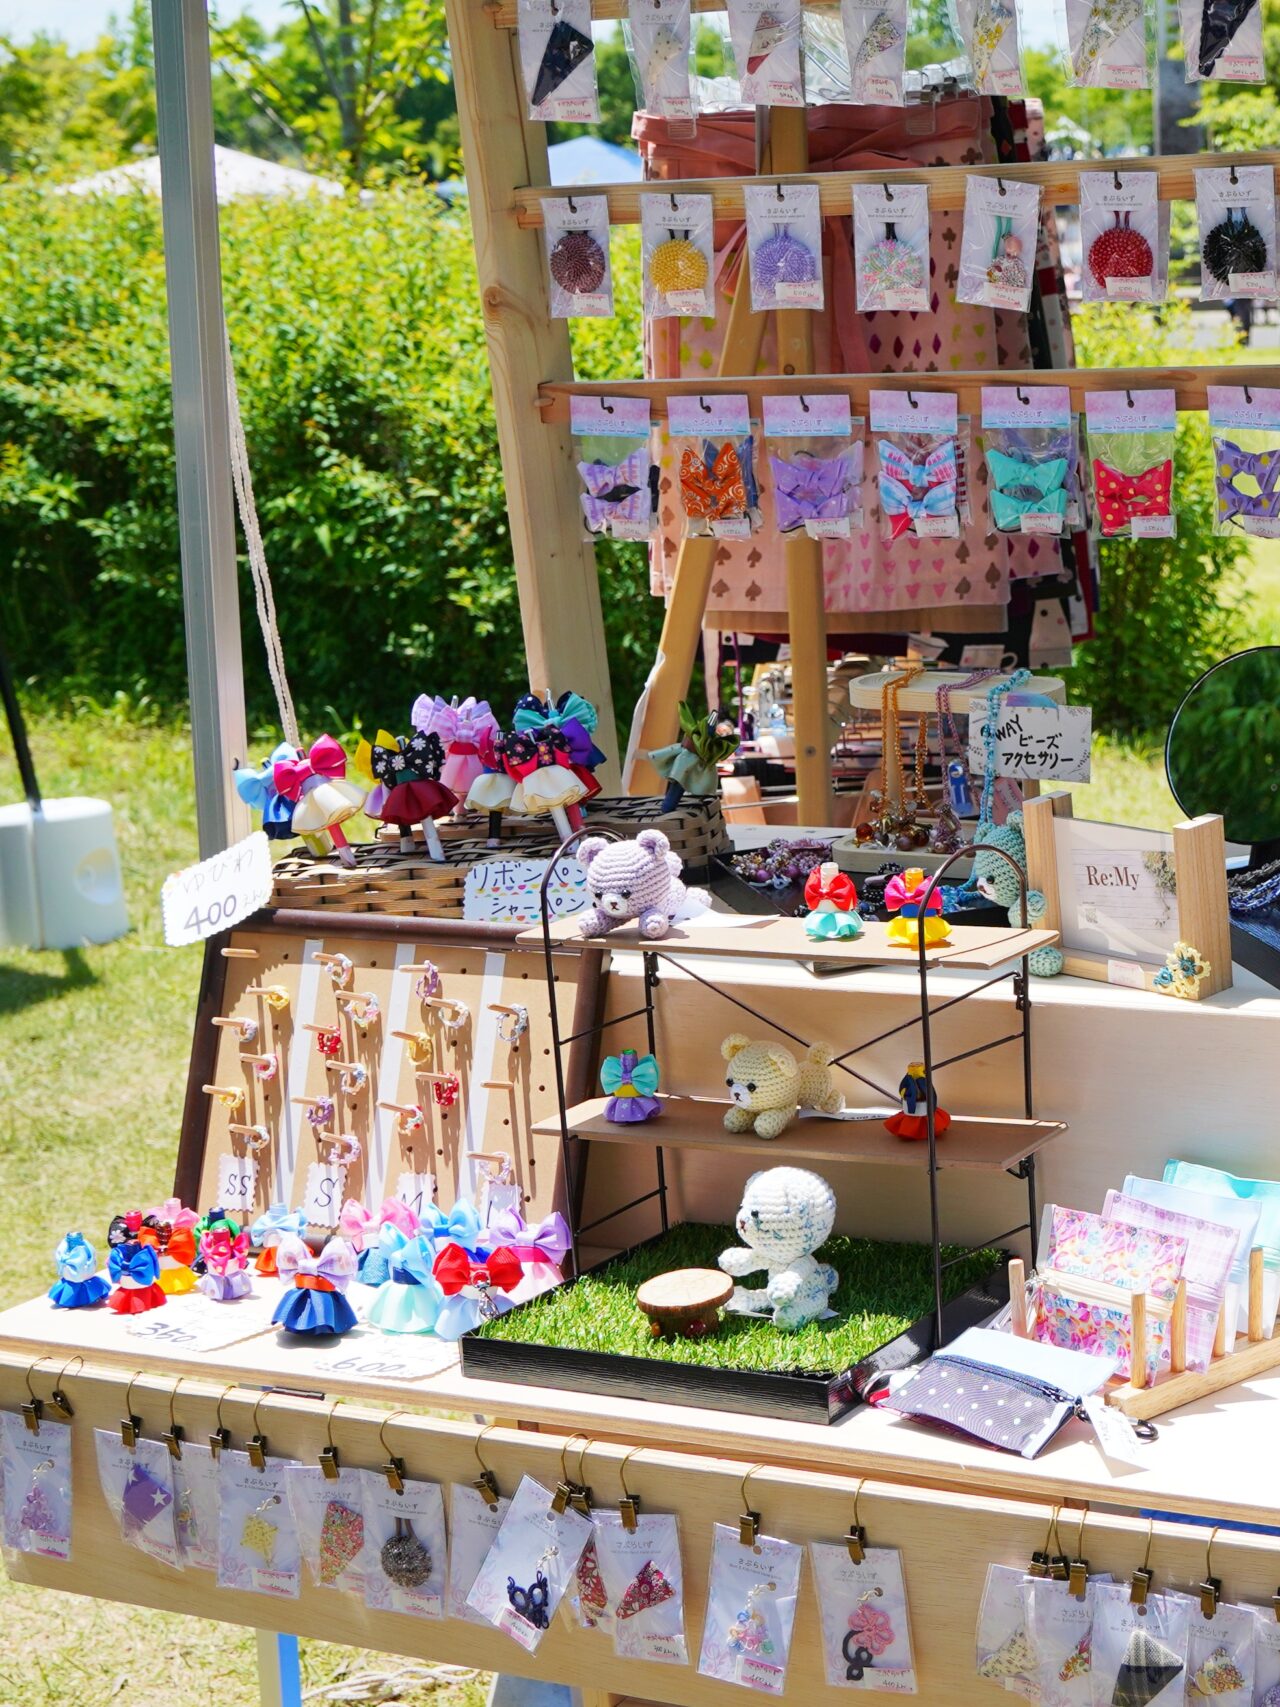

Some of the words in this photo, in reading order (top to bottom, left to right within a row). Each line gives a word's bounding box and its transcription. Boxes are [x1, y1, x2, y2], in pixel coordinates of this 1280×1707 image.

[981, 714, 1024, 741] WAY
[1019, 732, 1063, 750] ビーズ
[1002, 751, 1075, 769] アクセサリー
[183, 848, 254, 893] ゆびわ
[1086, 865, 1140, 890] Re:My
[225, 1172, 251, 1196] SS
[314, 1177, 339, 1208] S
